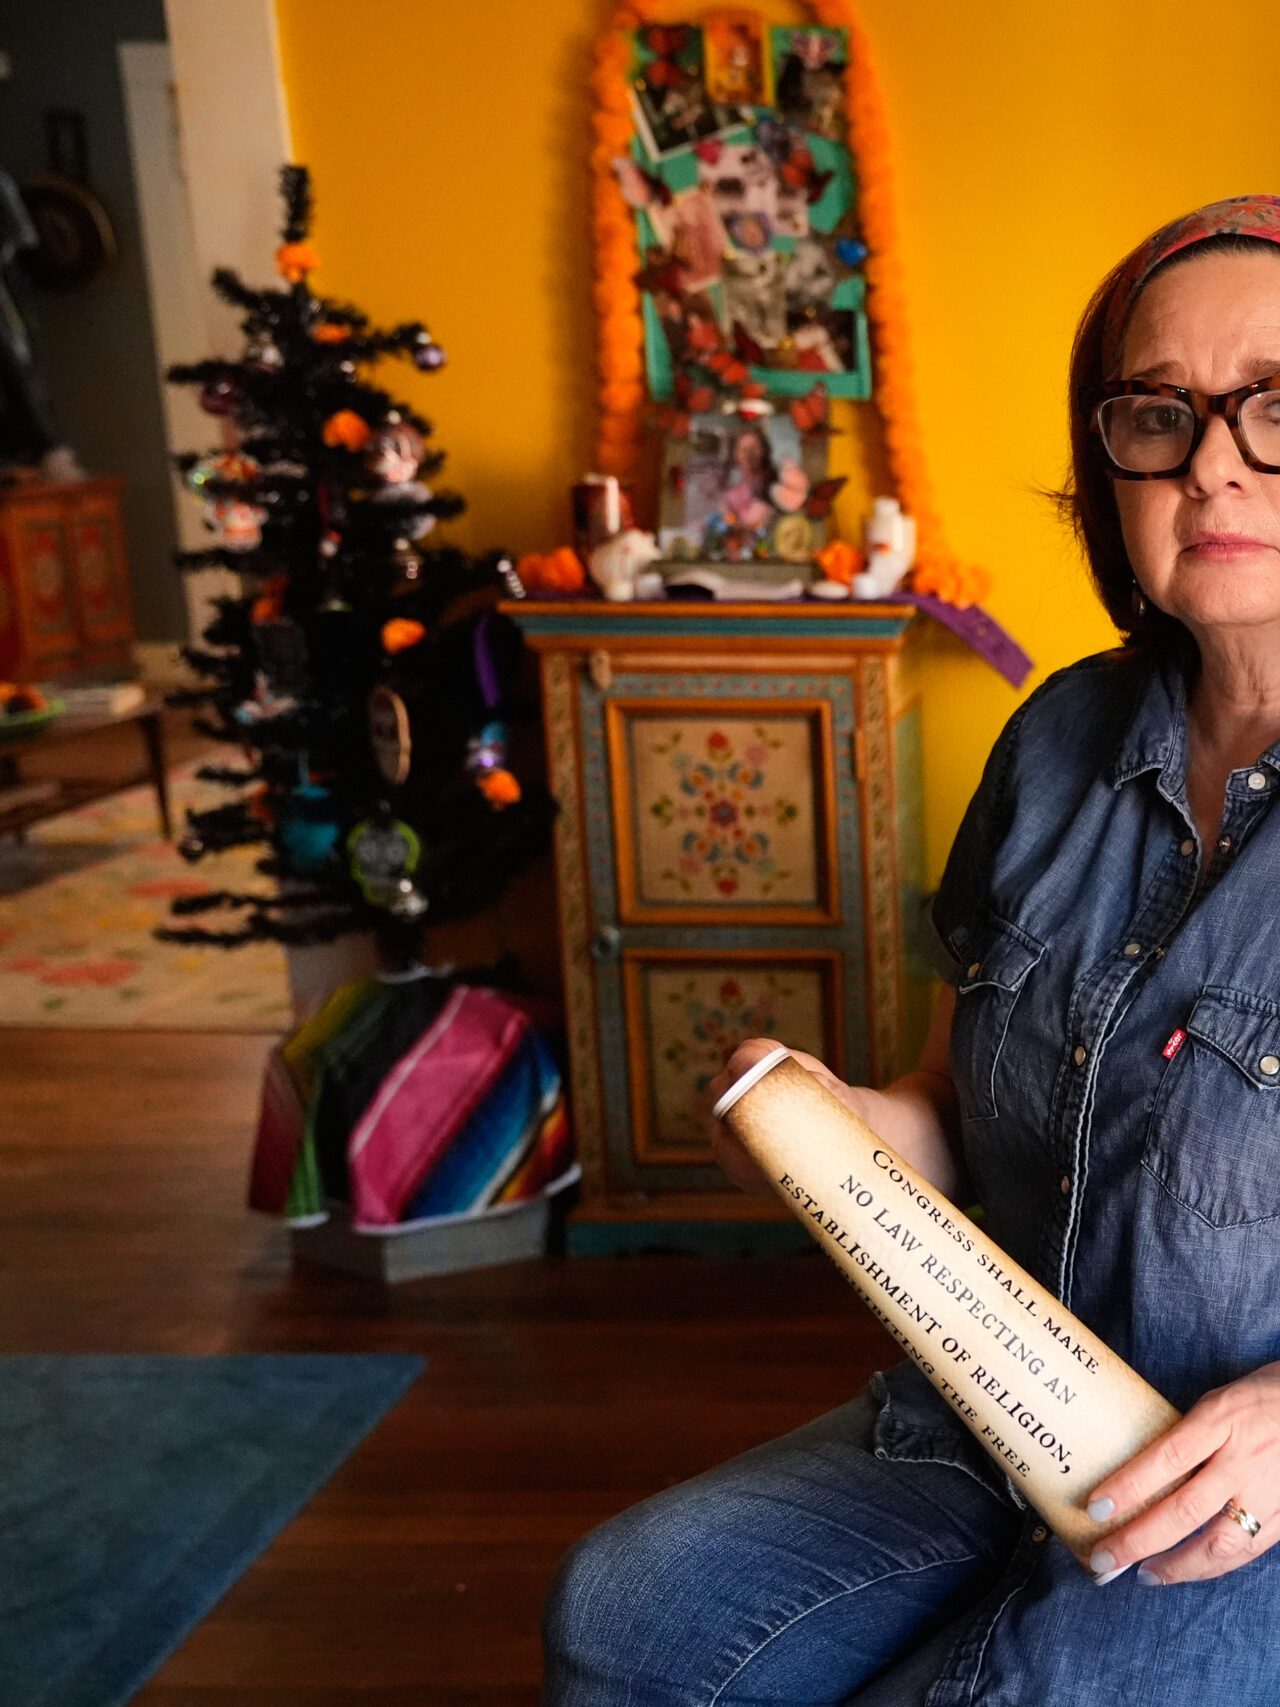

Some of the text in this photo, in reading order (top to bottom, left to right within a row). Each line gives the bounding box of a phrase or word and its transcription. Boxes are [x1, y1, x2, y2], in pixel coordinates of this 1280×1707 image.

[778, 1171, 1073, 1475] ESTABLISHMENT OF RELIGION,
[839, 1173, 1078, 1405] NO LAW RESPECTING AN
[976, 1253, 1037, 1317] SHALL
[1043, 1317, 1100, 1375] MAKE
[940, 1377, 978, 1422] THE
[981, 1424, 1031, 1478] FREE
